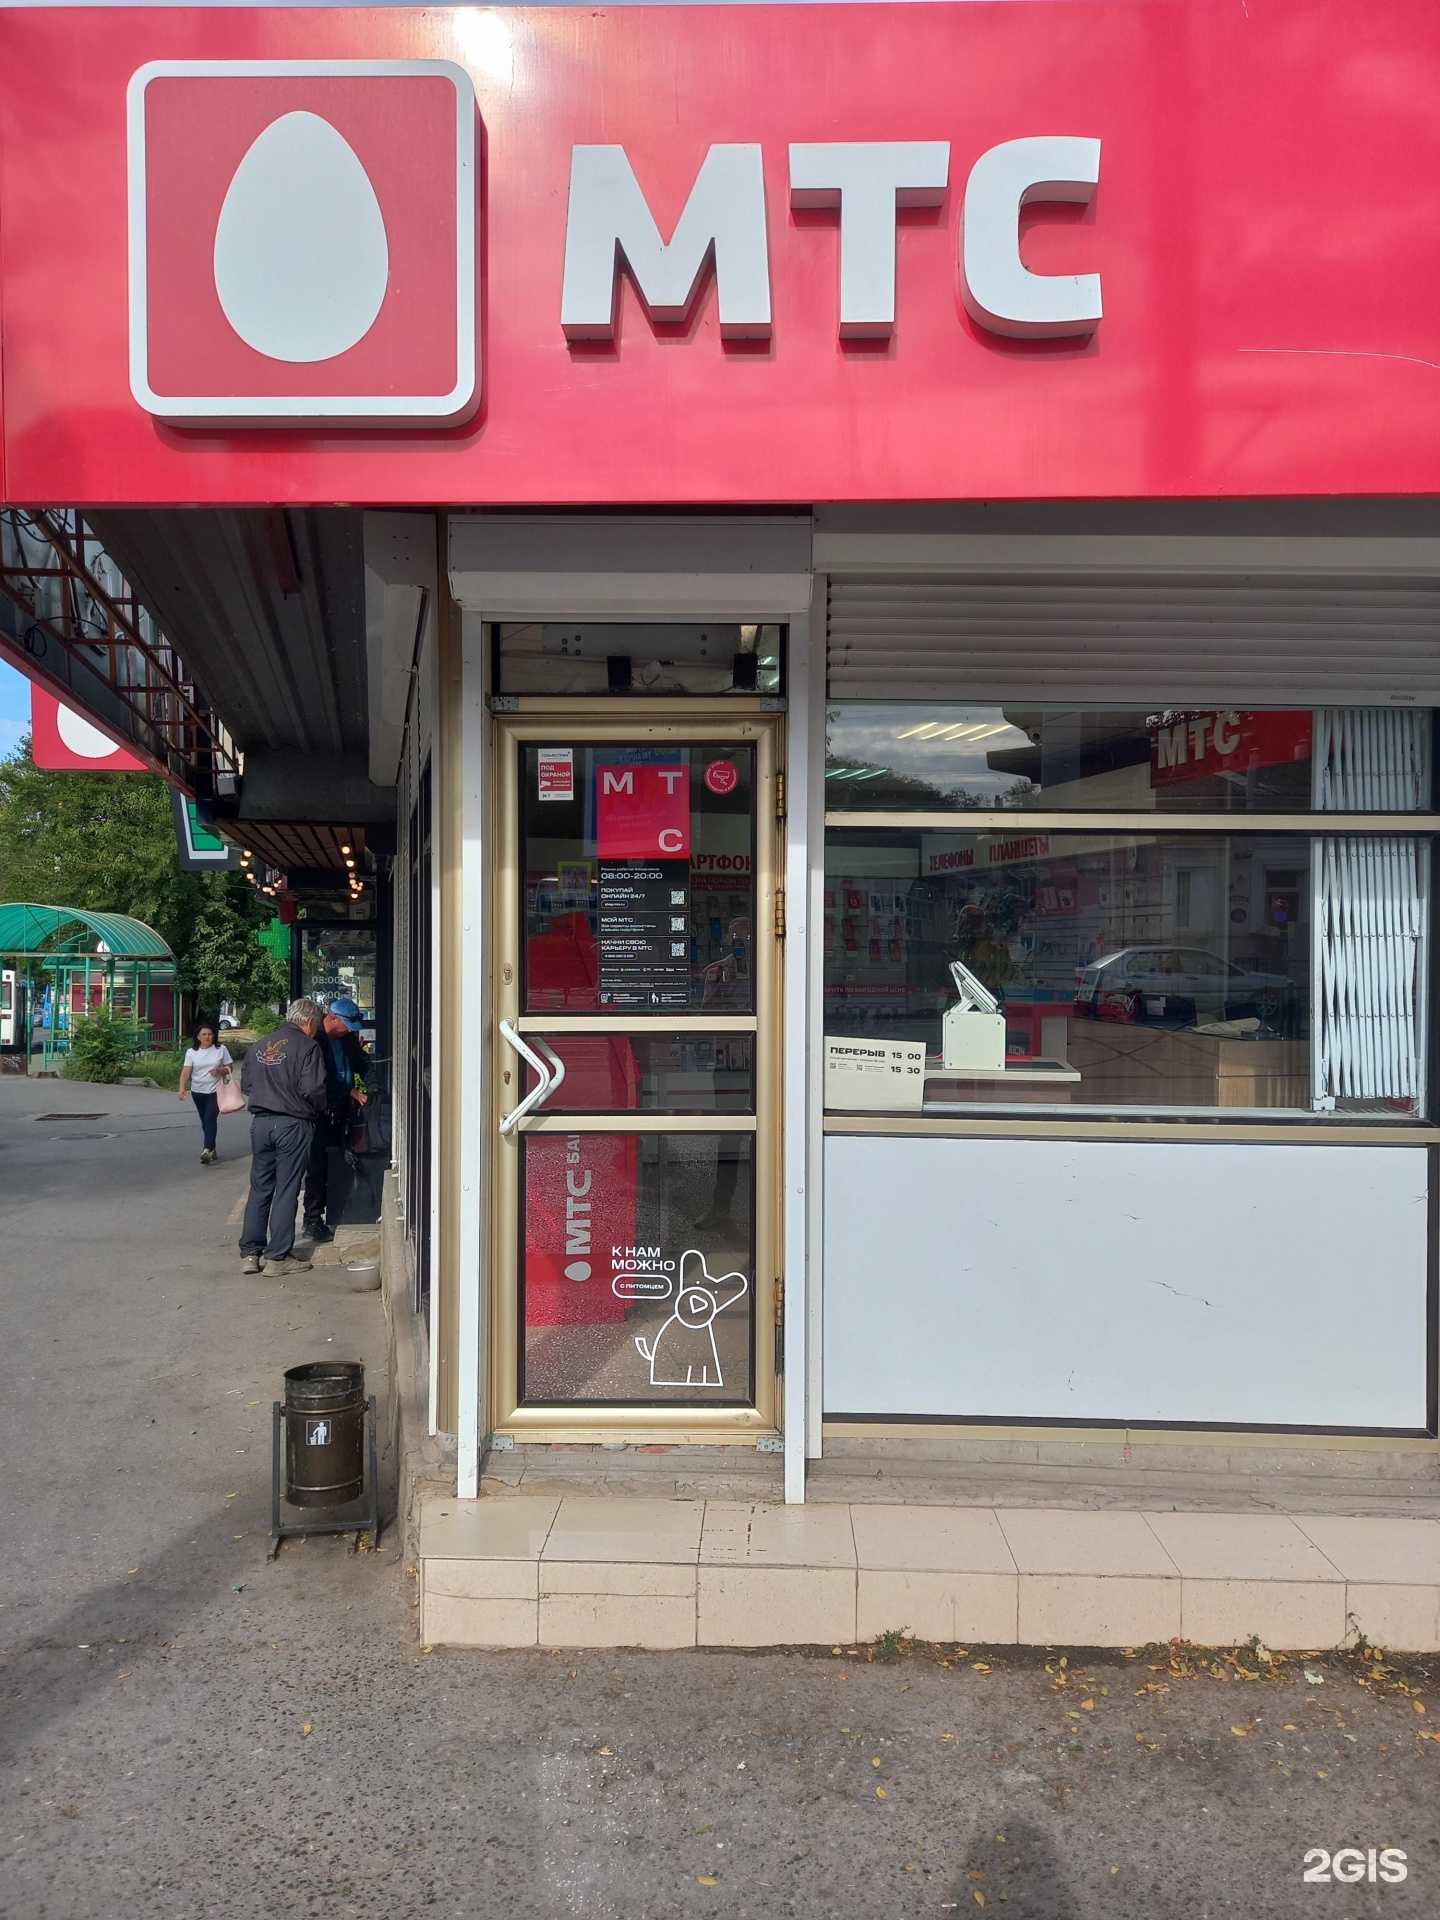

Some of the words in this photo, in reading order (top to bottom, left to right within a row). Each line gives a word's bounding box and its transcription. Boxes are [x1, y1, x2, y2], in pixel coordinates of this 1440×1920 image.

[561, 135, 1103, 339] МТС
[1157, 714, 1241, 769] МТС
[601, 872, 663, 880] 08:00-20:00
[830, 1047, 886, 1058] ПЕРЕРЫВ
[566, 1169, 592, 1255] МТС
[612, 1246, 622, 1257] К
[625, 1246, 661, 1258] НАМ
[611, 1259, 676, 1271] МОЖНО
